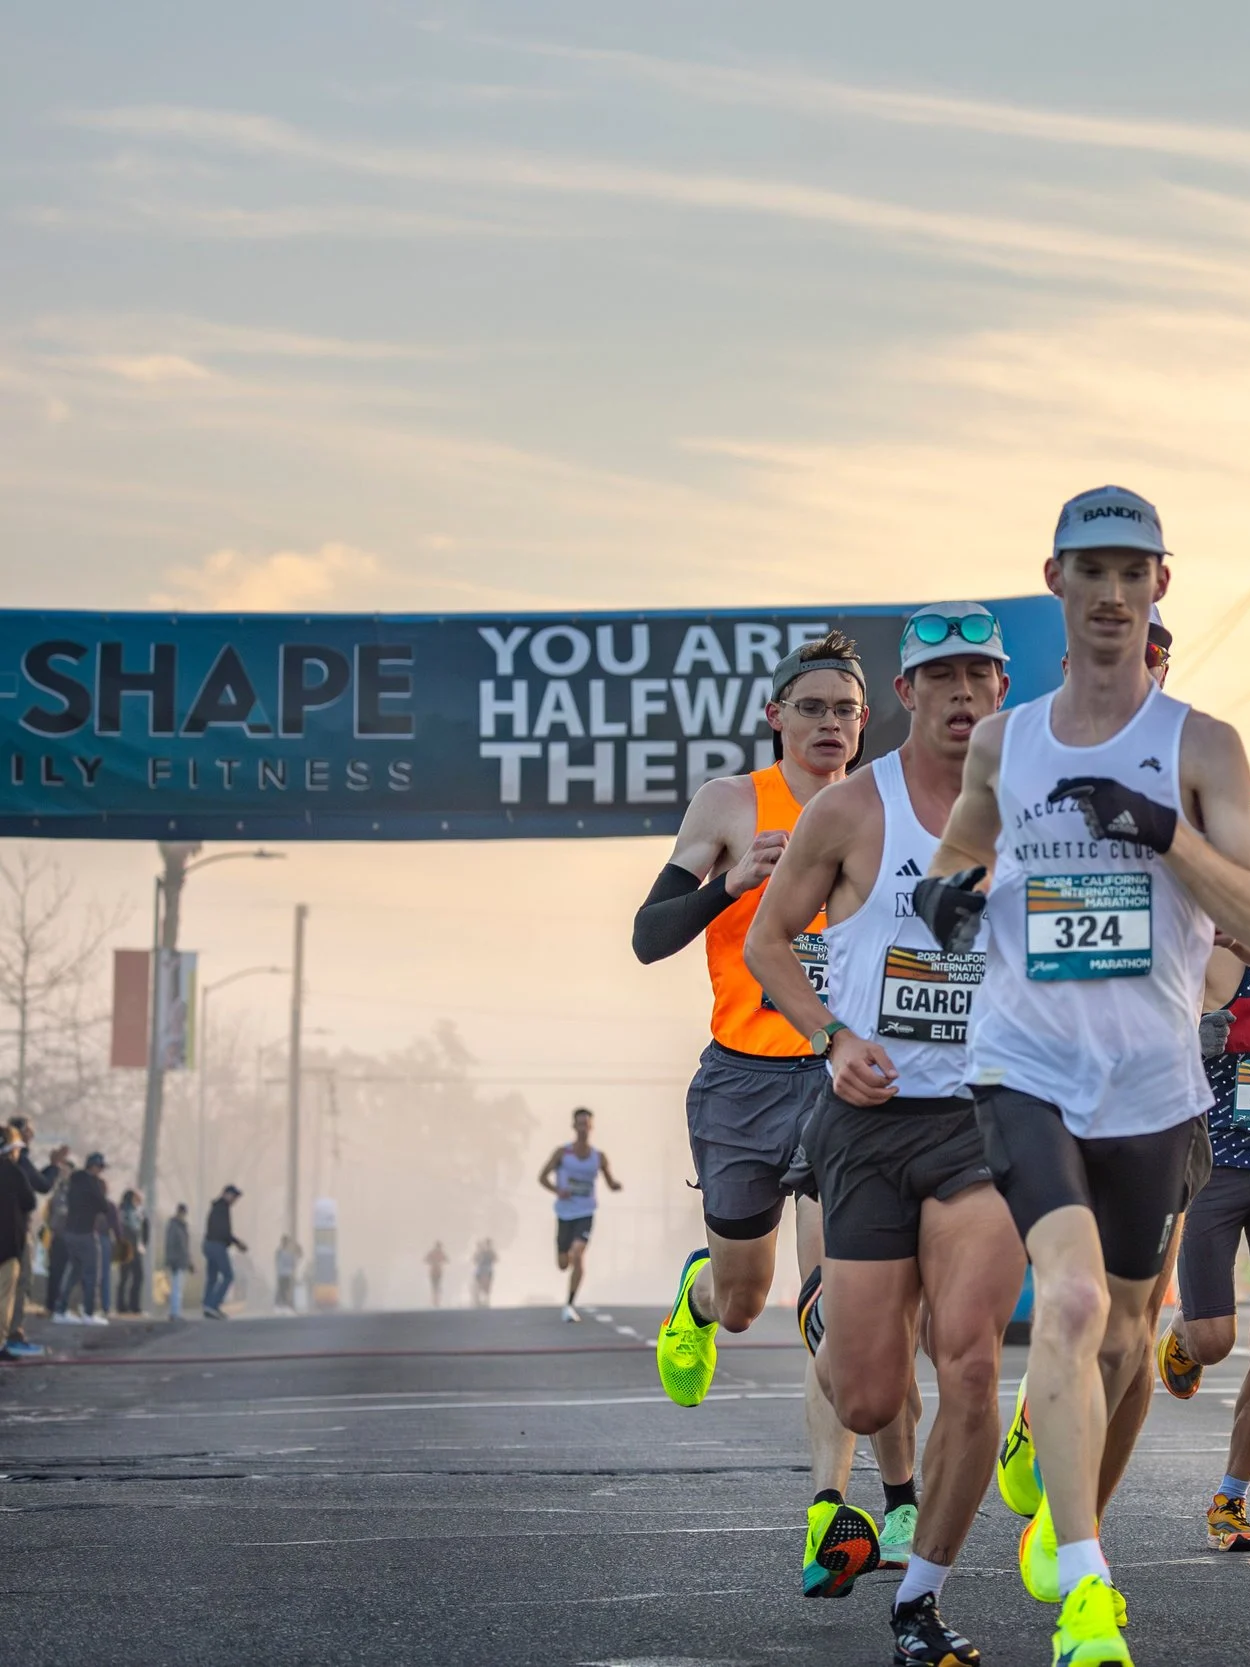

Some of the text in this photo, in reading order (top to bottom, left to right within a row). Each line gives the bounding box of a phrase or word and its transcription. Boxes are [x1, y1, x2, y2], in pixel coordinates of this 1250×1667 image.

[1083, 506, 1142, 523] BANDIT
[477, 624, 651, 677] YOU
[479, 677, 776, 738] HALFWA
[147, 757, 413, 792] FITNESS
[1016, 799, 1080, 829] JACUZZ
[1109, 841, 1155, 860] CLUB
[1081, 875, 1150, 887] CALIFORNIA
[1060, 886, 1149, 898] INTERNATIONAL
[1084, 896, 1150, 908] MARATHON
[1054, 914, 1123, 949] 324
[916, 952, 941, 961] 2024
[946, 953, 986, 963] CALIFOR
[1089, 957, 1151, 970] MARATHON
[930, 962, 986, 972] INTERNATIO
[948, 972, 983, 982] MARAT
[896, 986, 972, 1015] GARCI
[930, 1024, 966, 1040] ELIT
